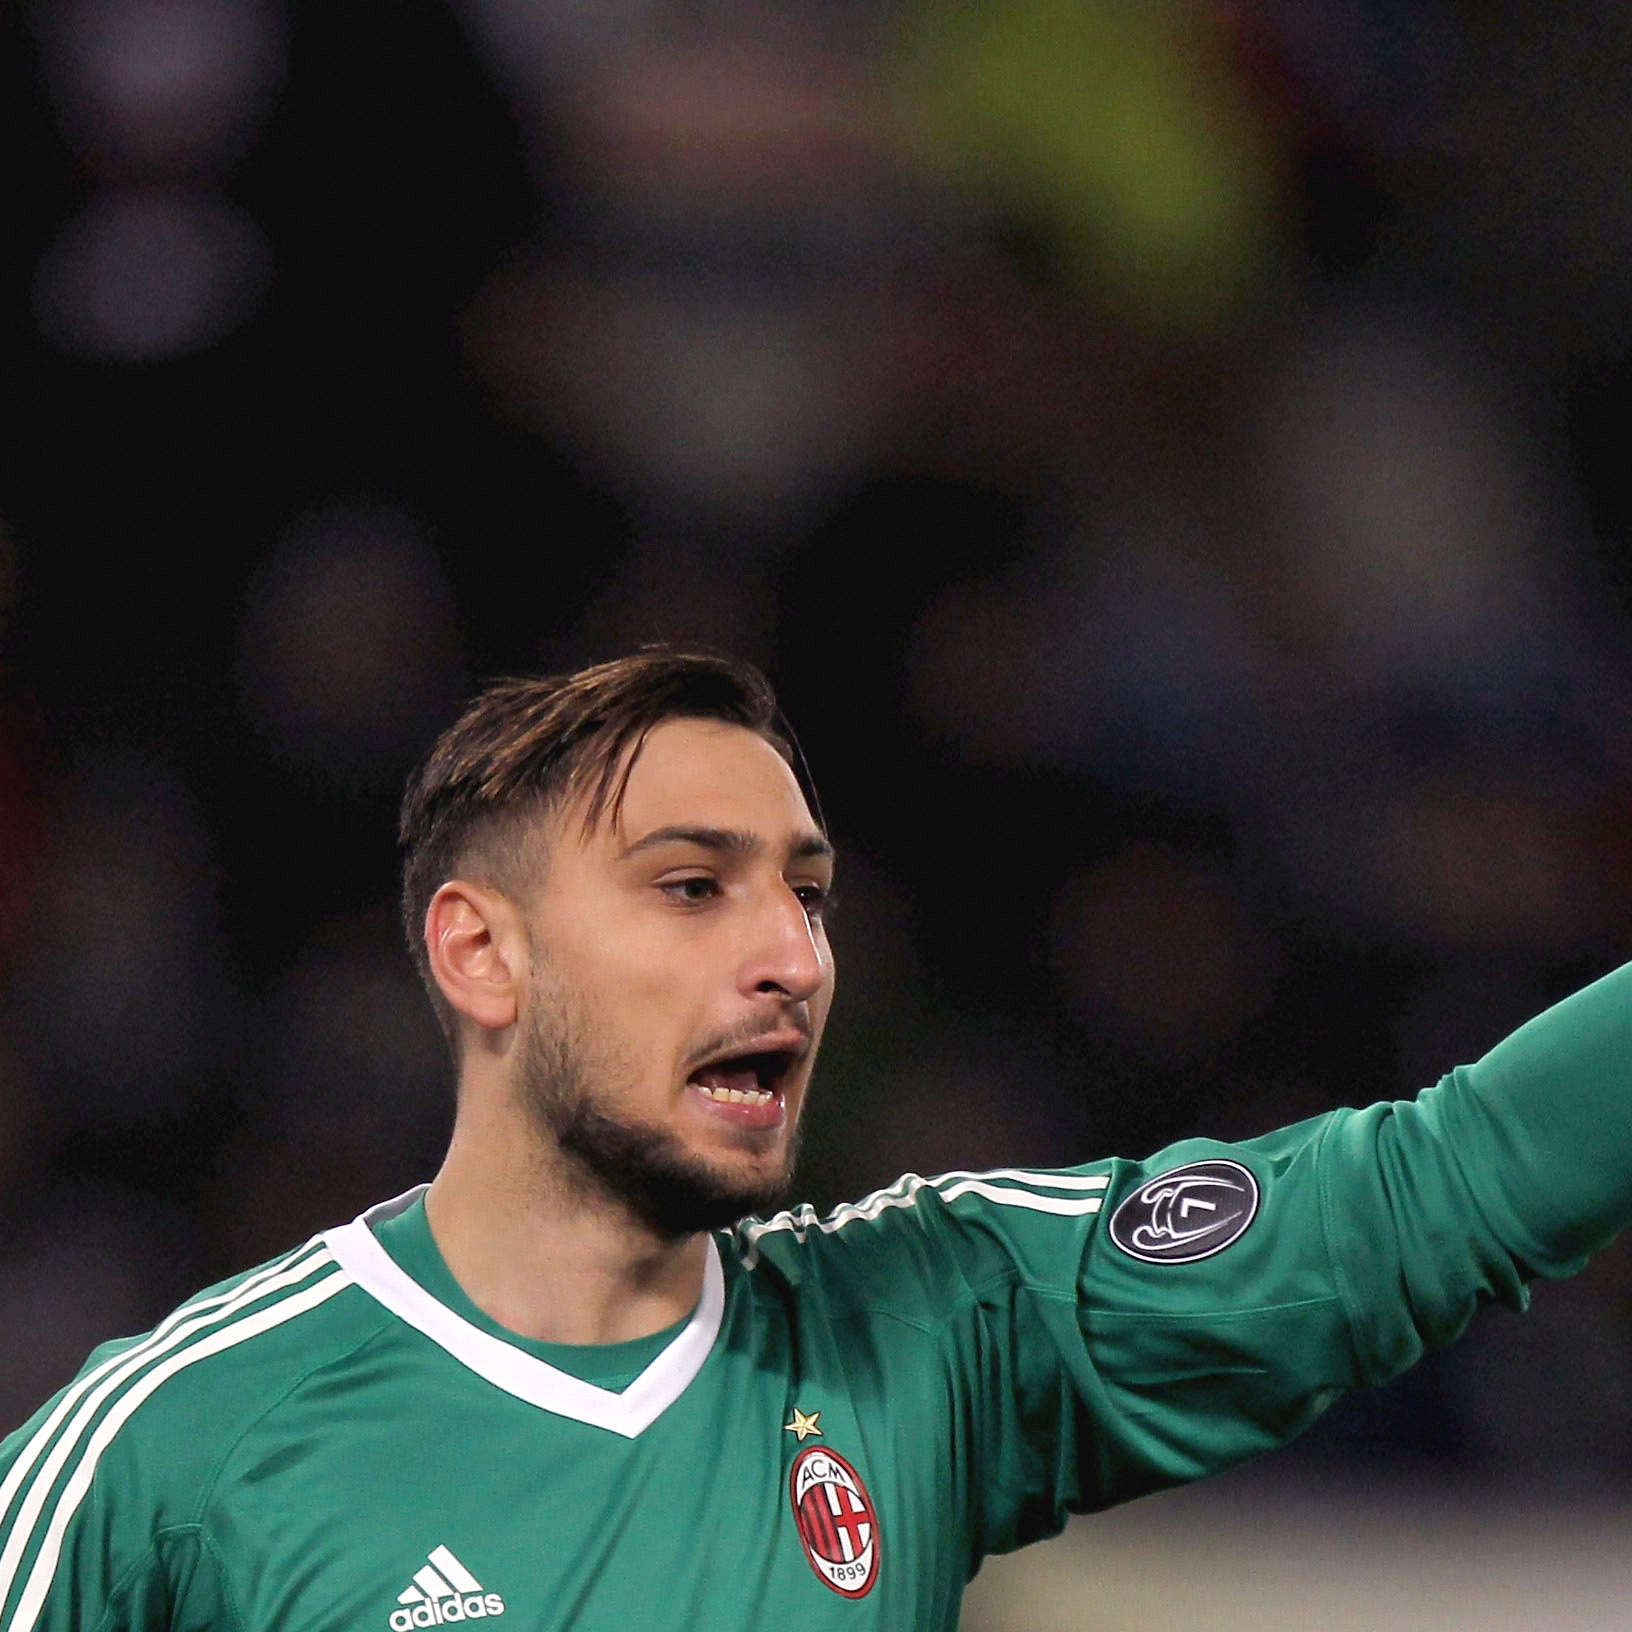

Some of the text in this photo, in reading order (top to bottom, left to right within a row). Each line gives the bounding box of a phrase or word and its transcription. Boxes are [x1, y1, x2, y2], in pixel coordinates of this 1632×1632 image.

[802, 1459, 846, 1489] ACM
[829, 1562, 867, 1581] 1899
[389, 1590, 505, 1632] adidas
